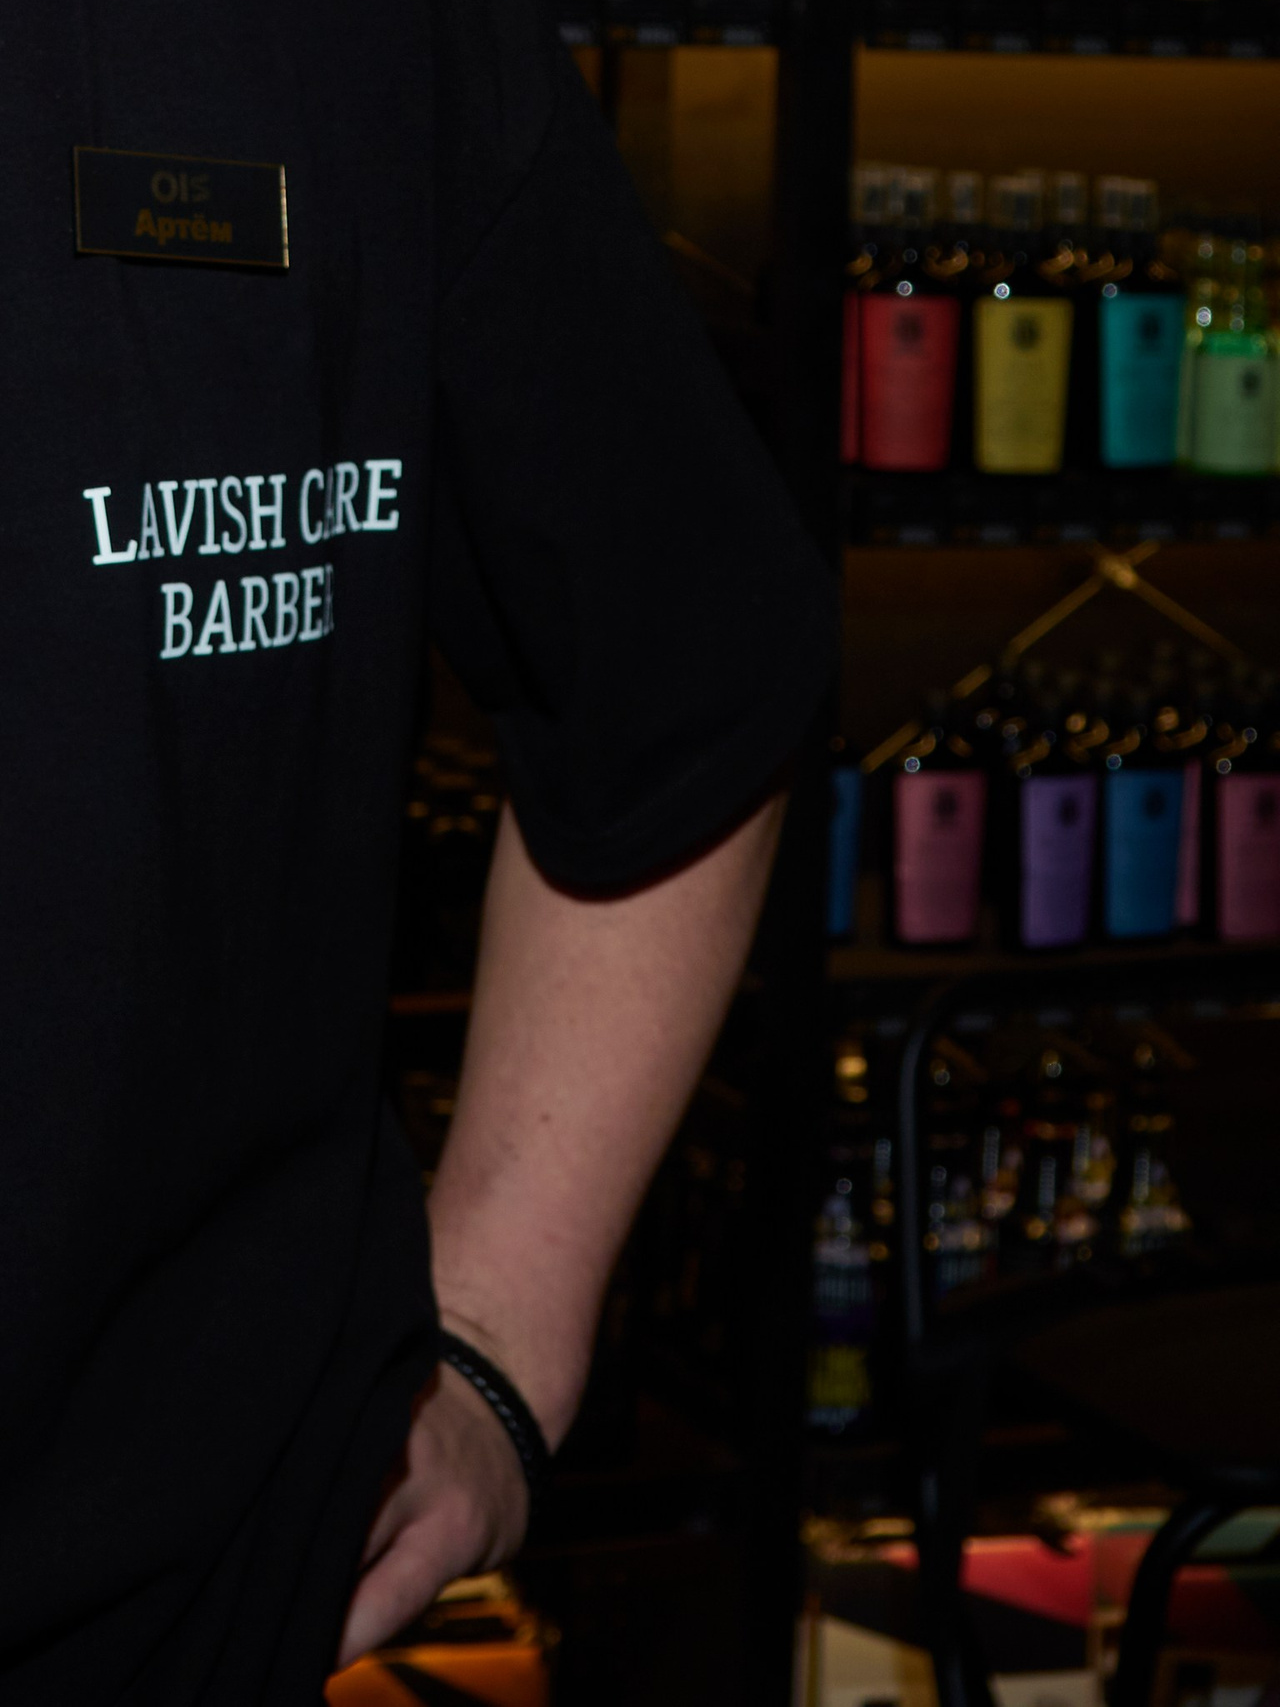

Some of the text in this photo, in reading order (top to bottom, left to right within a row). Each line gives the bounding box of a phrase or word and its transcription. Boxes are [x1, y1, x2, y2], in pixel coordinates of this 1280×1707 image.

[151, 170, 211, 203] OIS
[135, 208, 233, 247] Артём
[83, 473, 287, 566] LAVISH
